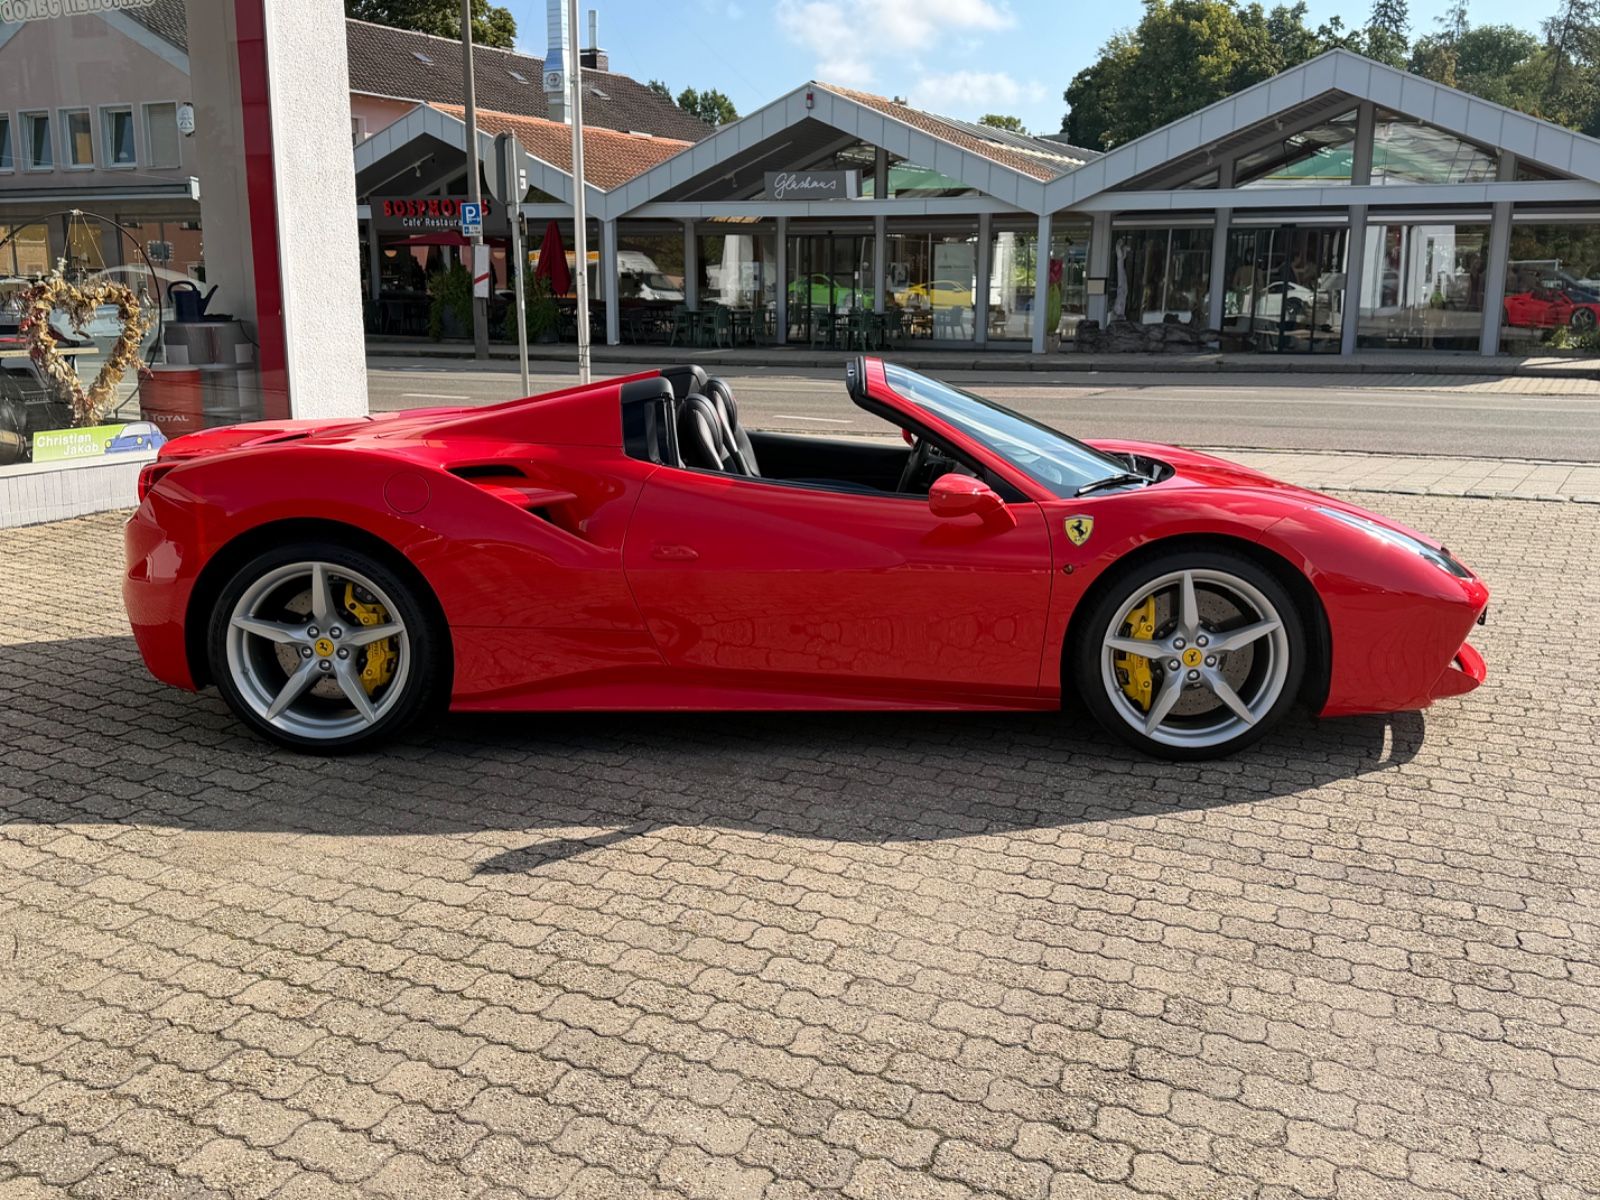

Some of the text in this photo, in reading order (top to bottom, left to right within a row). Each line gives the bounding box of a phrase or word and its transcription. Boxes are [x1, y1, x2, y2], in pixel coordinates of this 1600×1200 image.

[425, 218, 462, 227] Restaura
[36, 434, 91, 448] Christian
[63, 445, 98, 456] Jakob
